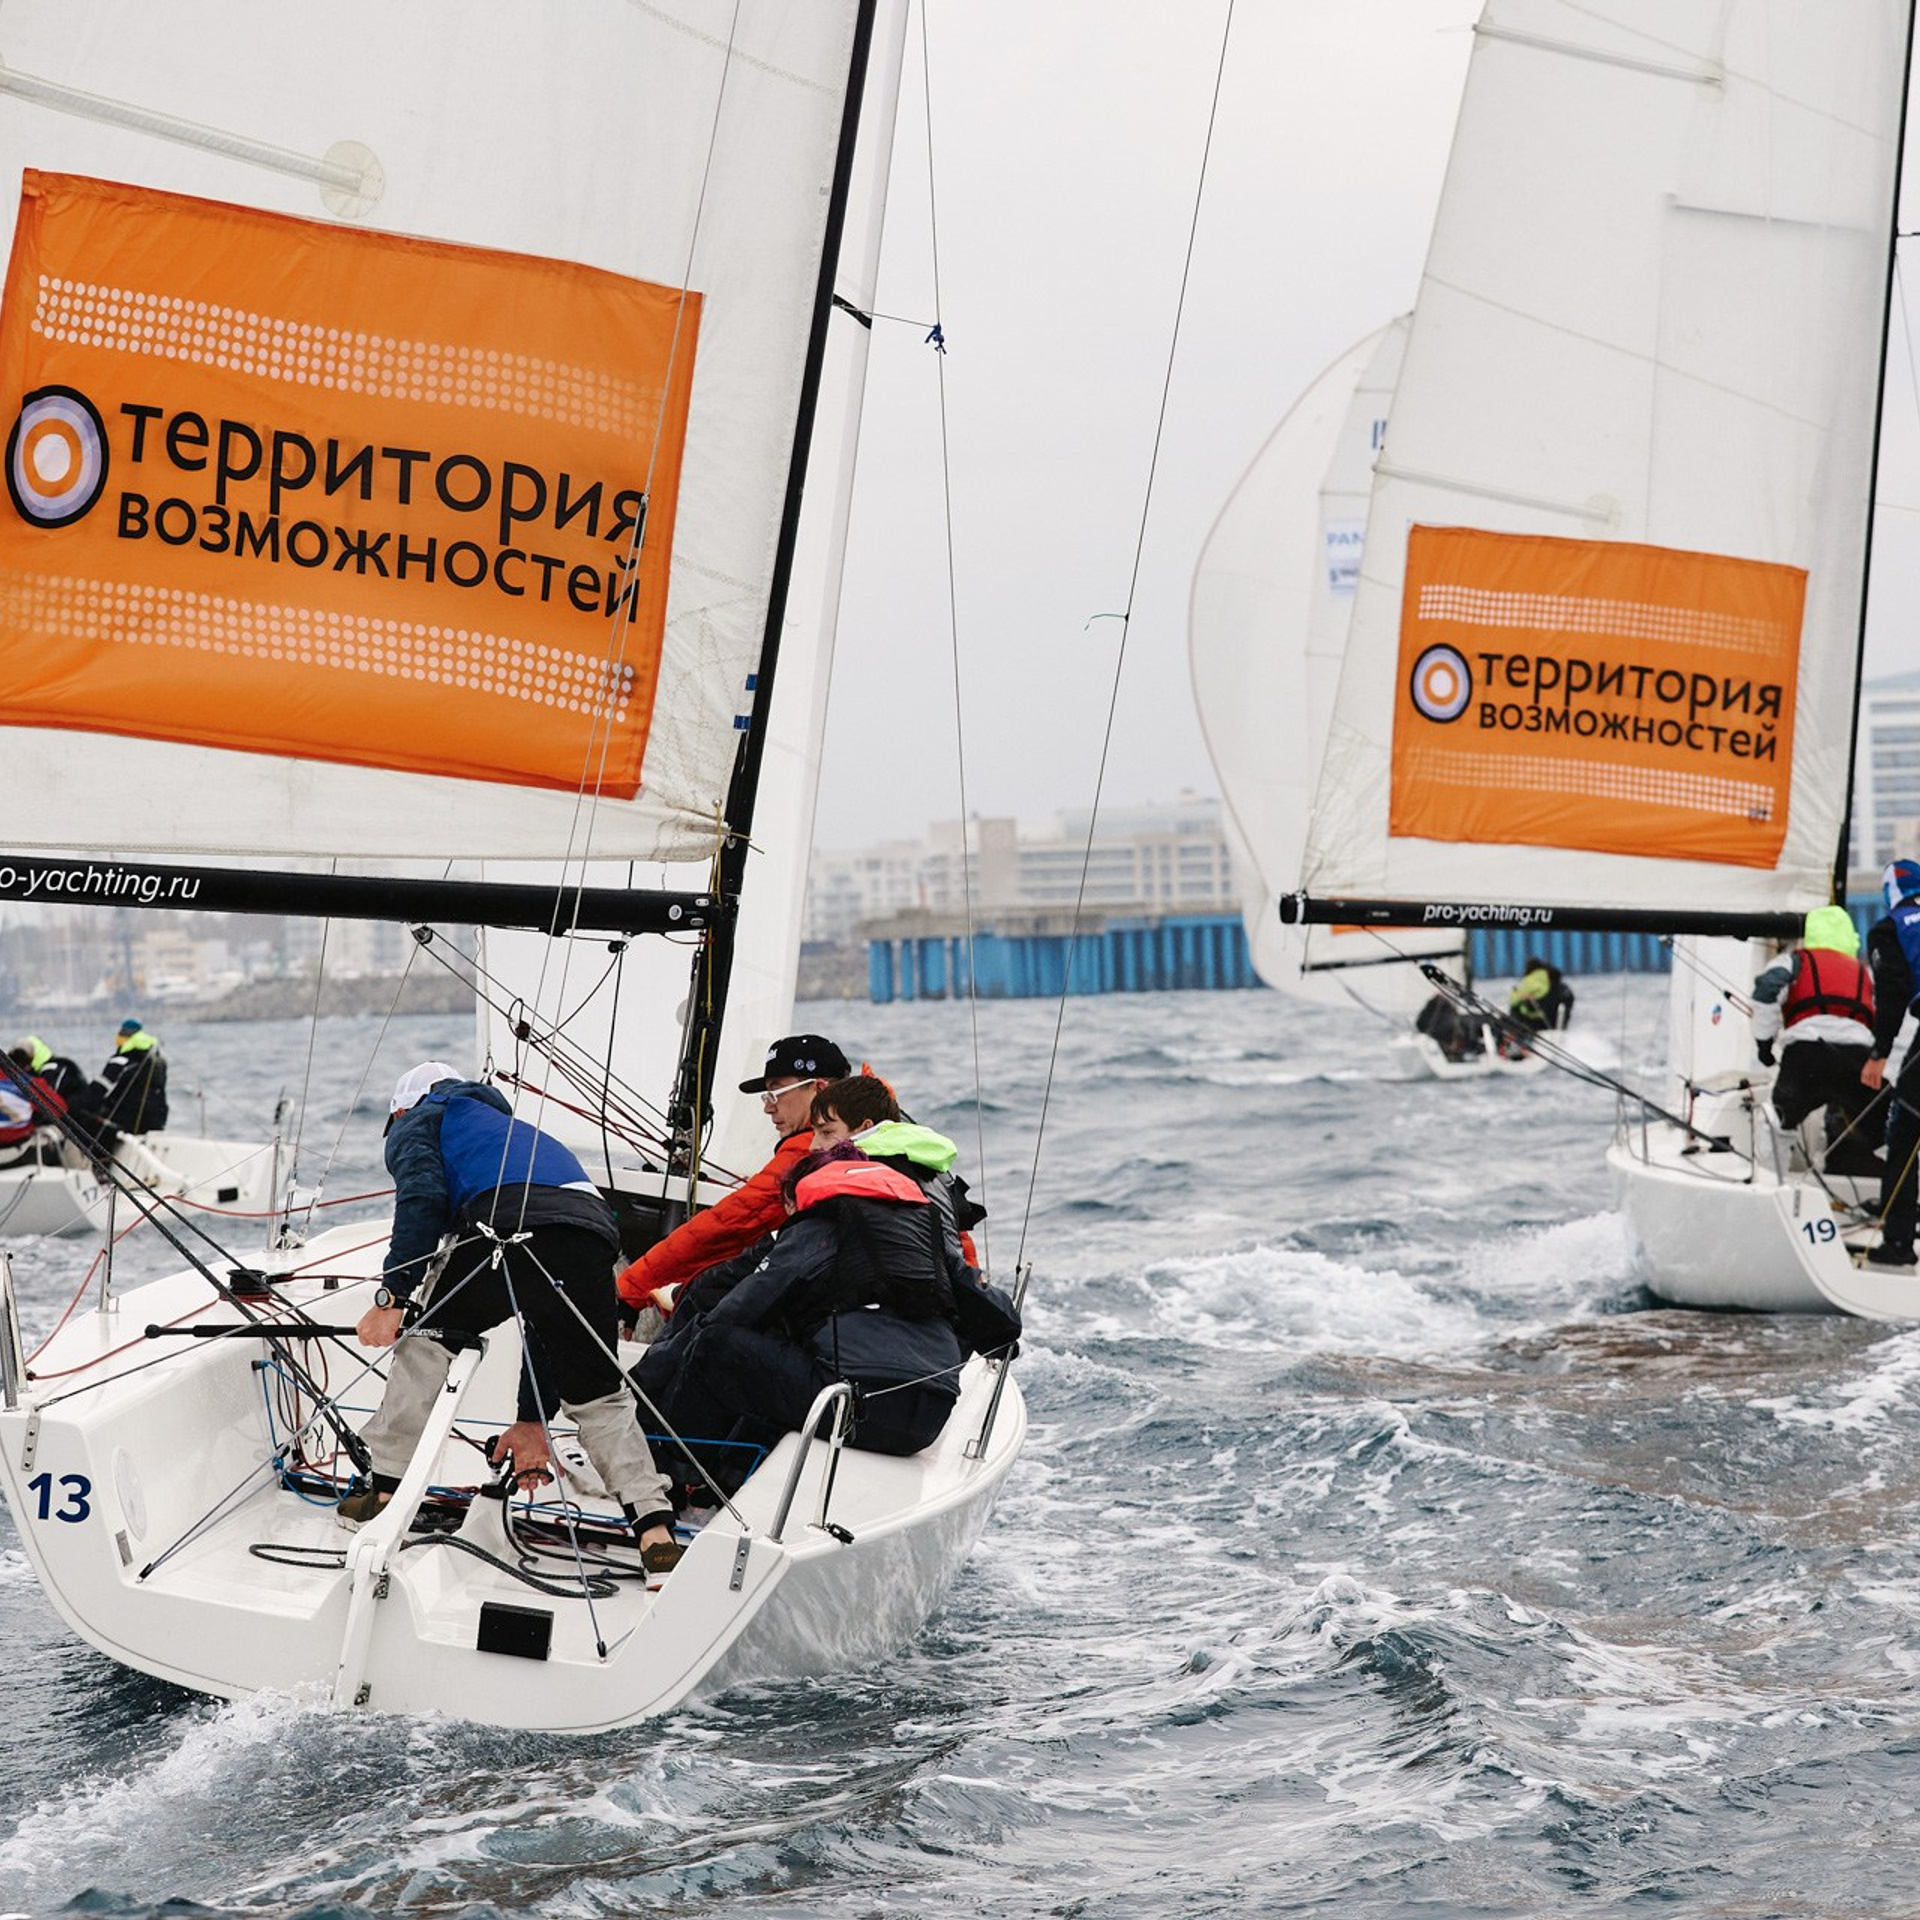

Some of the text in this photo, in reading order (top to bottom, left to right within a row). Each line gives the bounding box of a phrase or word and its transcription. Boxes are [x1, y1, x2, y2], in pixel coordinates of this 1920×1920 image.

[119, 402, 650, 550] территория
[117, 491, 641, 624] возможностей
[1477, 652, 1783, 720] территория
[1479, 702, 1777, 763] возможностей
[1423, 904, 1554, 927] pro-yachting.ru
[1802, 1219, 1836, 1244] 19
[27, 1473, 92, 1524] 13
